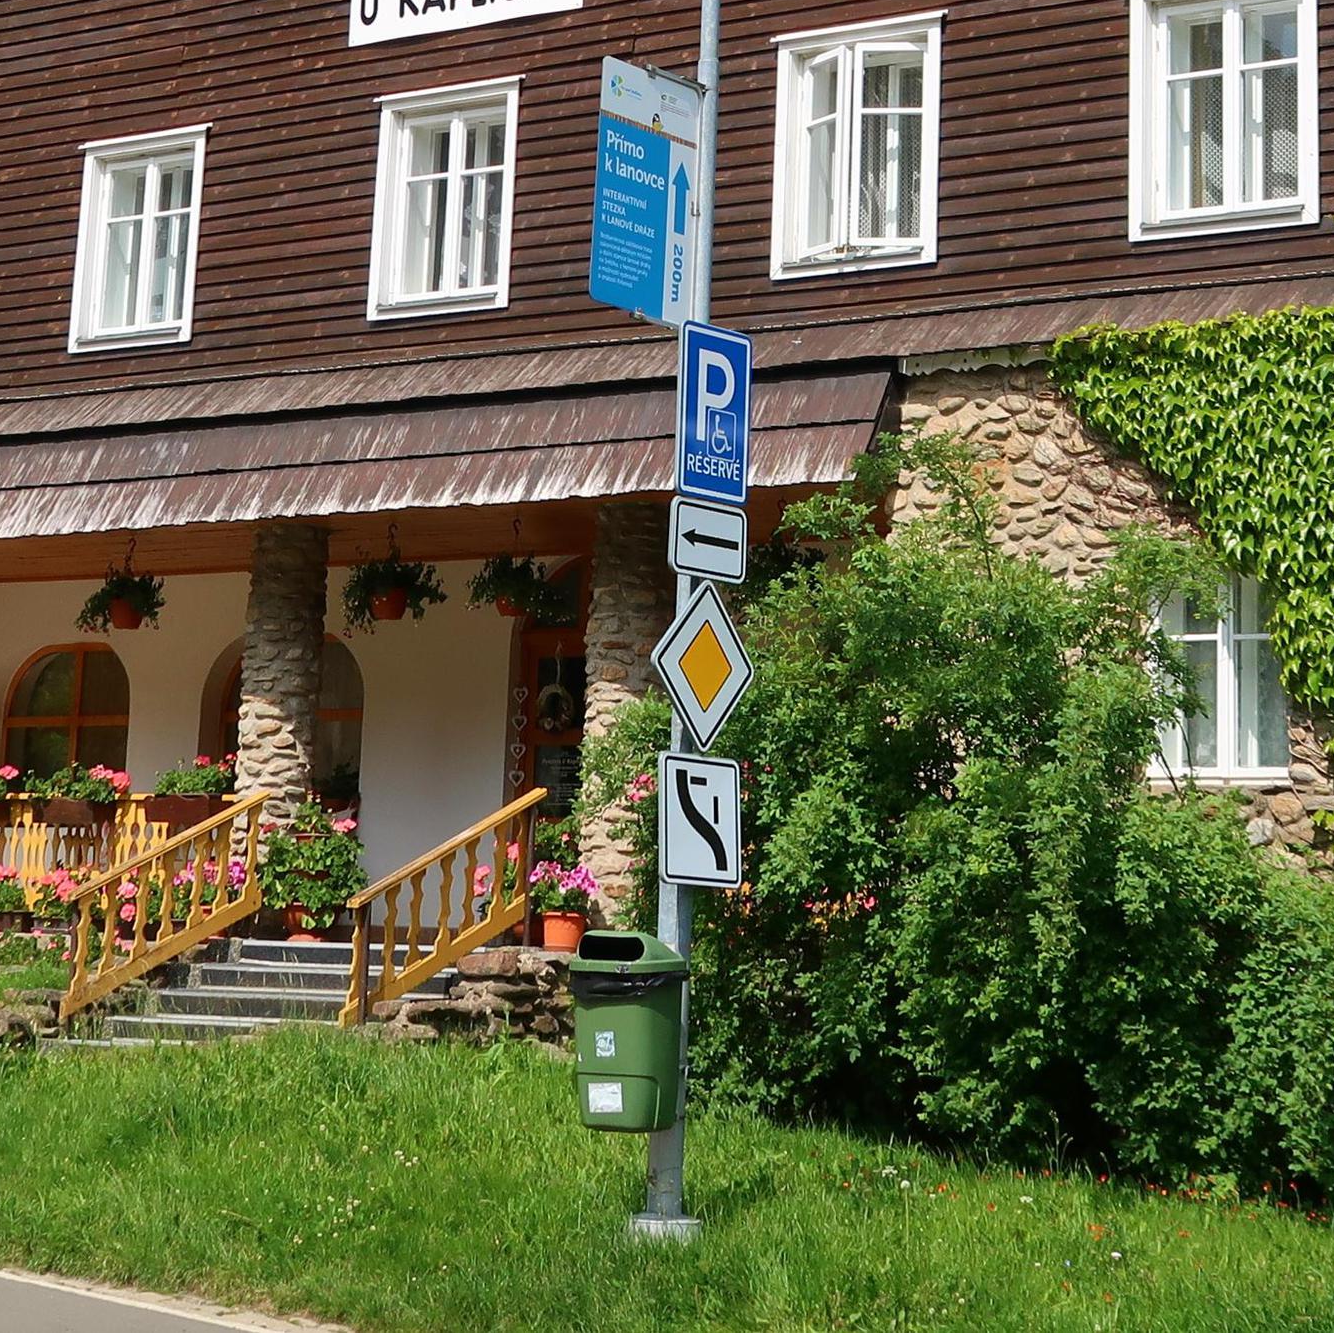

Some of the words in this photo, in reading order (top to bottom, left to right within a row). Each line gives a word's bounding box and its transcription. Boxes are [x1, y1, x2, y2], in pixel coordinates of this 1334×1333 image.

[607, 129, 645, 160] Přímo
[604, 152, 613, 173] k
[616, 156, 665, 190] lanovce
[602, 200, 627, 217] STEZKA
[671, 243, 684, 303] 200m
[696, 348, 736, 442] P
[687, 451, 741, 482] RÉSERVÉ
